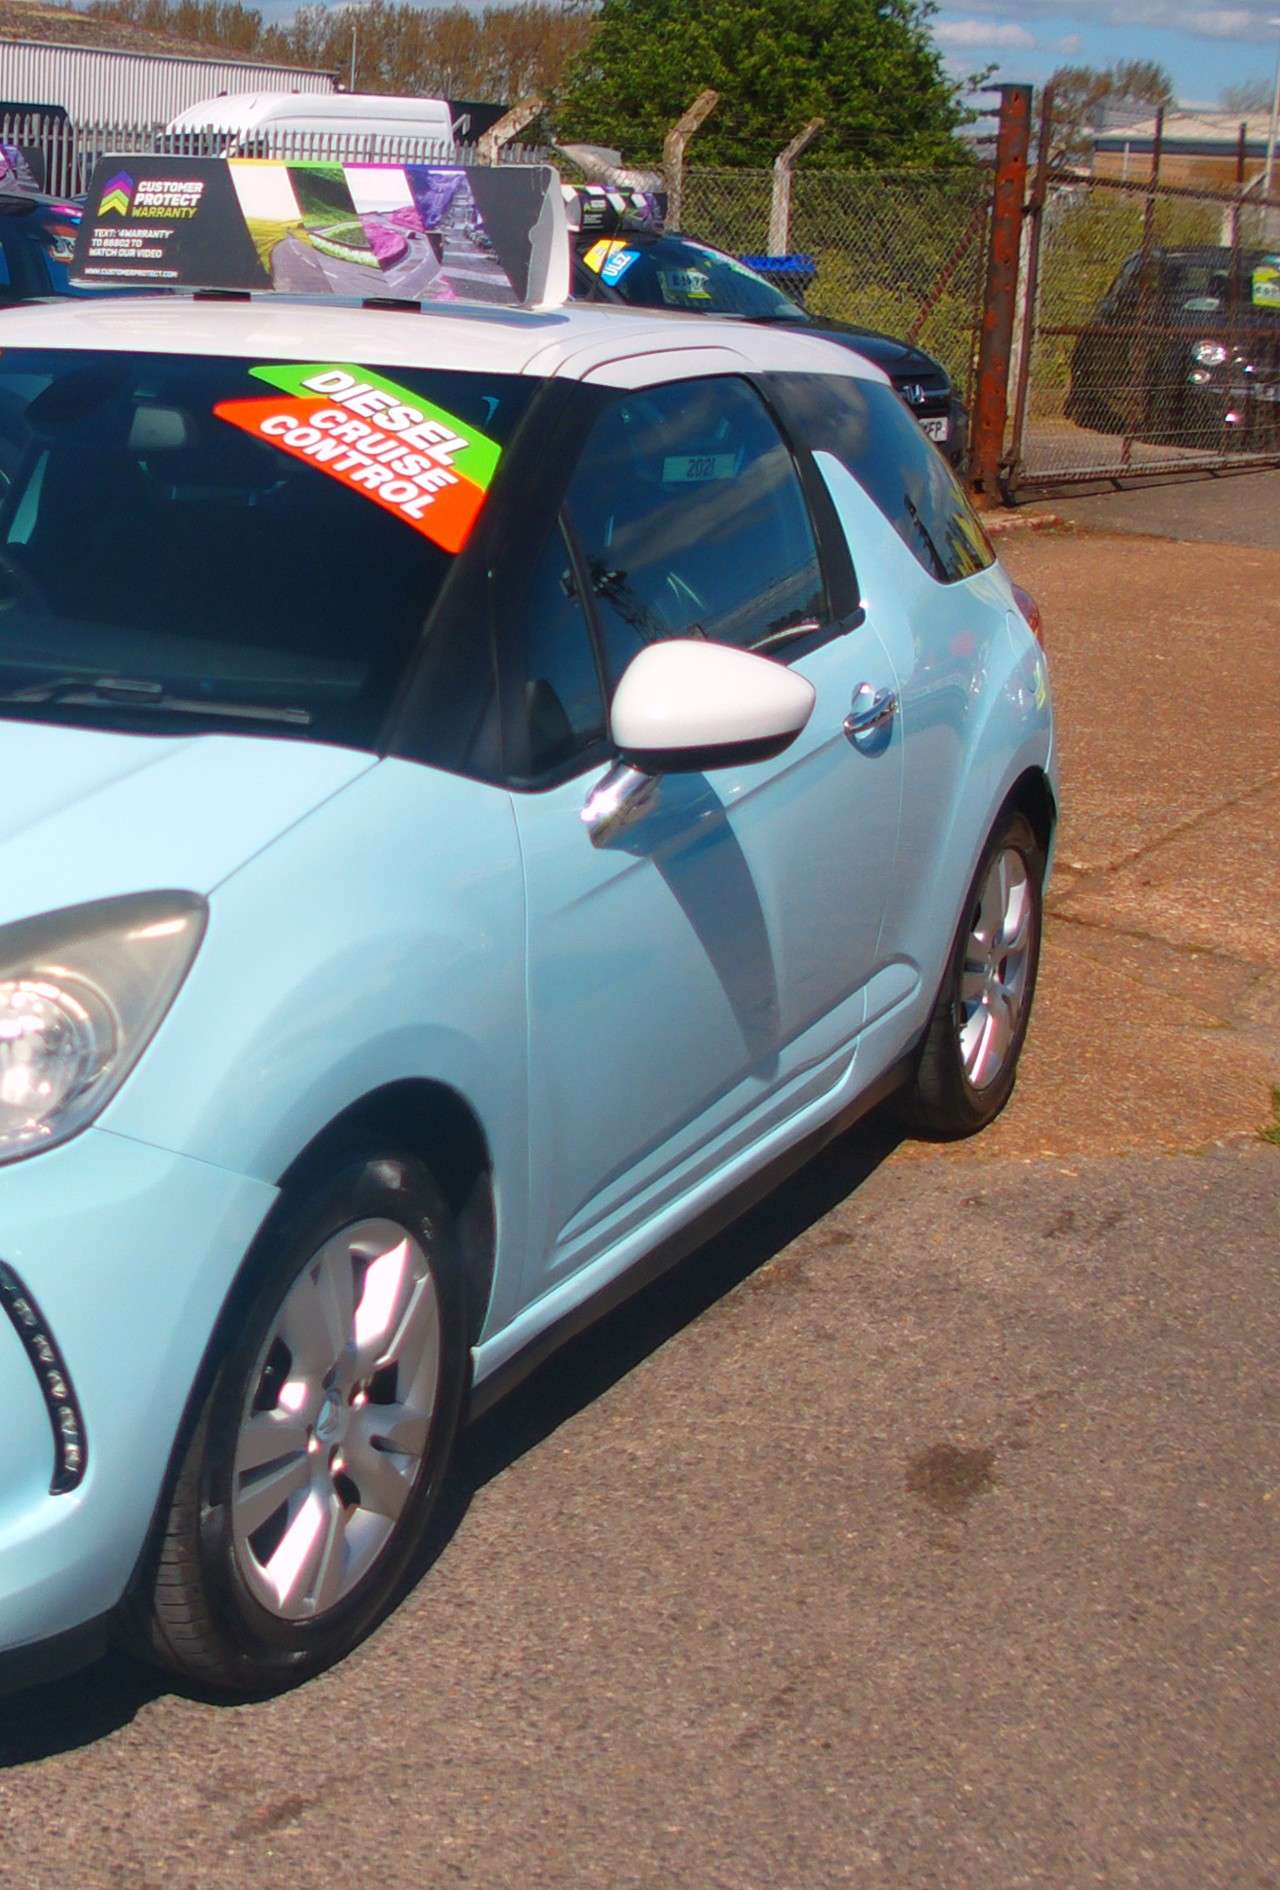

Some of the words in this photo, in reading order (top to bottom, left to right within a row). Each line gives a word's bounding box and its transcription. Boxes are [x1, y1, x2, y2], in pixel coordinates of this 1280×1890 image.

[138, 180, 203, 193] CUSTOMER
[133, 193, 201, 207] PROTECT
[131, 207, 198, 219] WARRANTY
[131, 239, 143, 248] TO
[89, 248, 117, 257] WATCH
[137, 249, 163, 259] VIDEO
[602, 253, 631, 277] ULEZ
[300, 370, 470, 466] DIESEL
[309, 409, 459, 494] CRUISE
[260, 415, 436, 520] CONTROL
